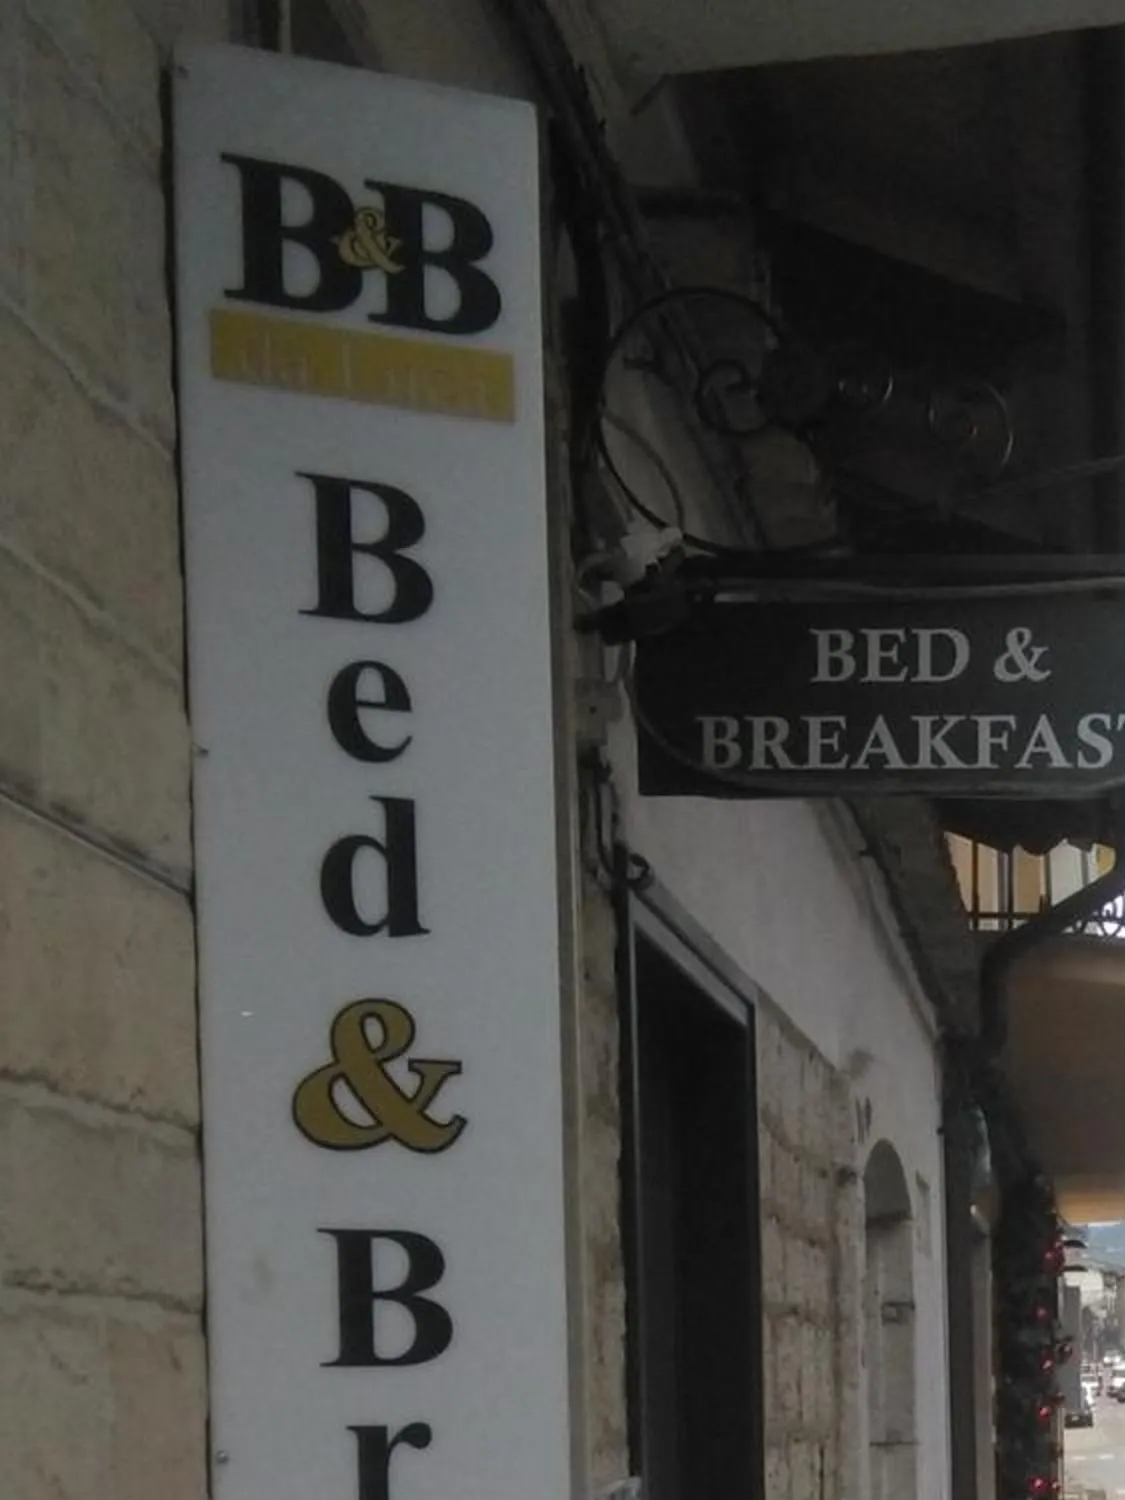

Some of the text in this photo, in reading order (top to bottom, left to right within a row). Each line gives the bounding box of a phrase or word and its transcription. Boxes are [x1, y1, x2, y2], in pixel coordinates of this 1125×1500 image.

[220, 152, 502, 335] B&B
[295, 471, 435, 938] Bed
[810, 627, 1052, 684] BED &
[291, 998, 468, 1155] &
